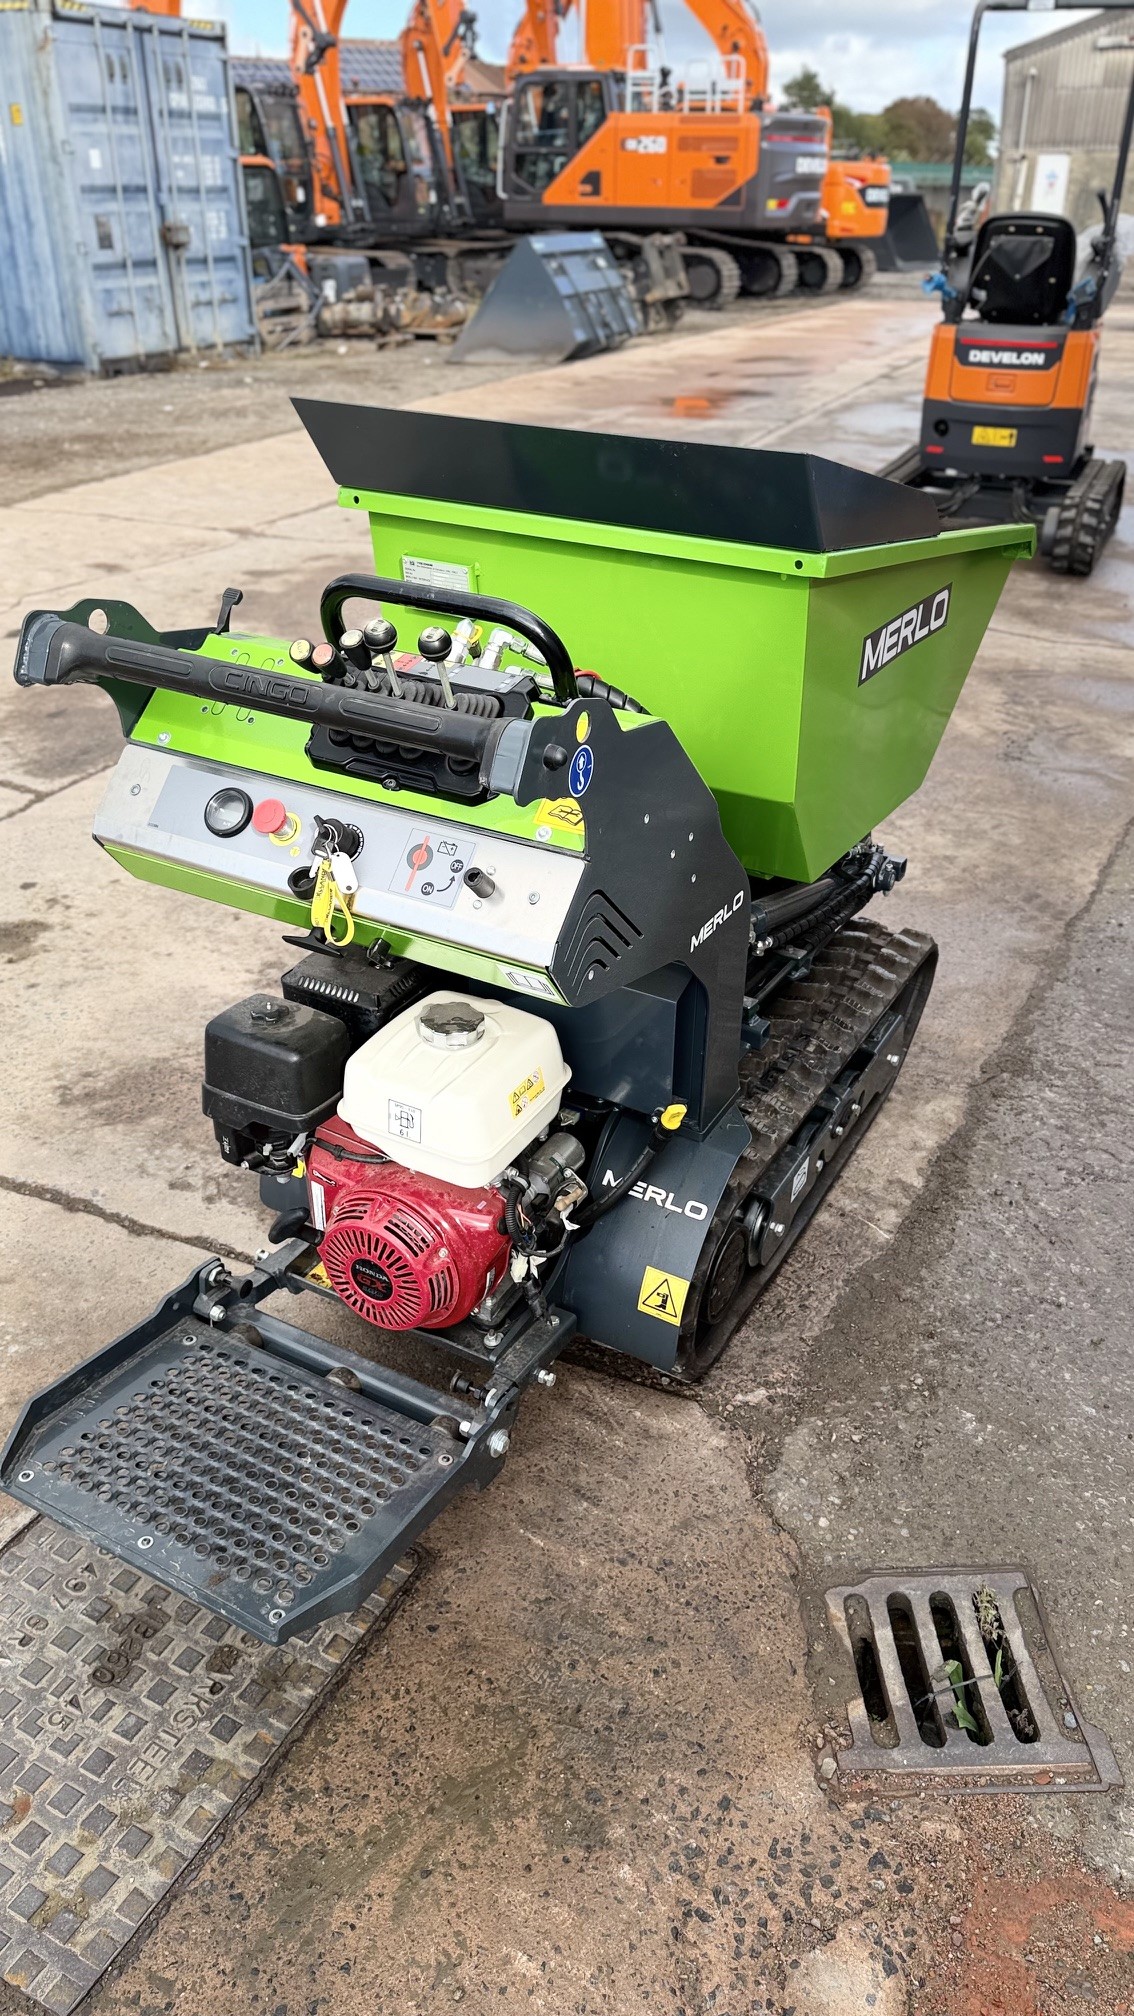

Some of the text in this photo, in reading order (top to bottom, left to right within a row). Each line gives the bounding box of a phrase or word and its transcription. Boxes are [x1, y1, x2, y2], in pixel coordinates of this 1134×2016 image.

[968, 349, 1046, 366] DEVELON
[861, 588, 949, 681] MERLO
[224, 672, 310, 705] CINGO
[451, 862, 464, 871] OFF
[422, 884, 433, 894] ON
[690, 890, 744, 953] MERLO
[602, 1169, 708, 1221] MERLO
[355, 1264, 389, 1282] HONDA
